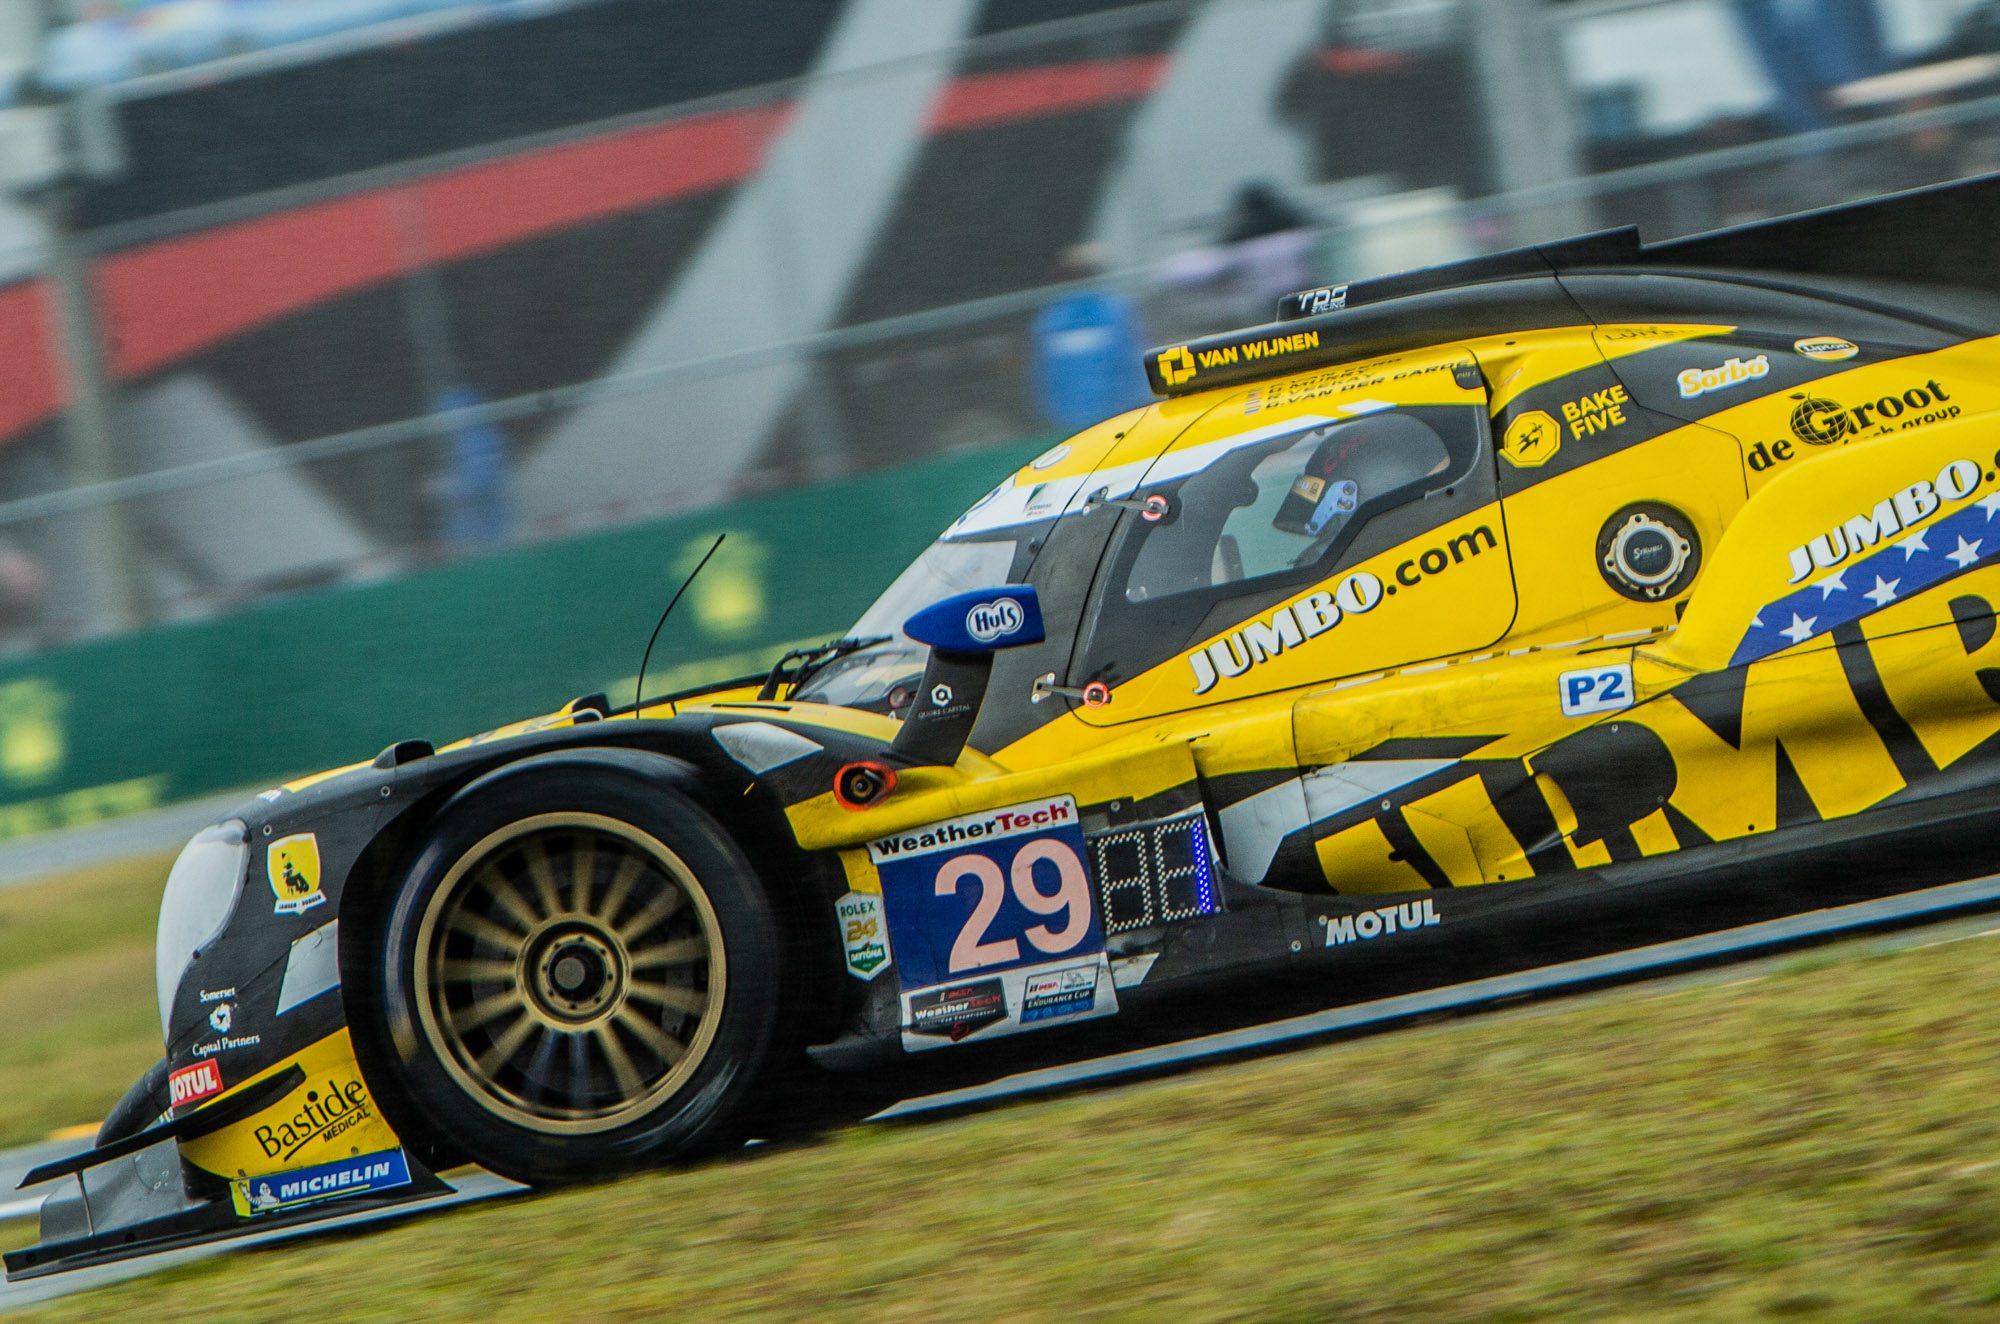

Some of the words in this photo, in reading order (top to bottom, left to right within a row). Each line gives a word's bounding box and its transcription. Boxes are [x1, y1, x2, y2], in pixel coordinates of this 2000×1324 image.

[1298, 285, 1348, 311] TDS
[1198, 345, 1239, 368] VAN
[1243, 331, 1319, 360] WIJNEN
[1679, 357, 1768, 397] Sorbo
[1561, 384, 1629, 423] BAKE
[1570, 404, 1627, 441] FIVE
[1748, 438, 1795, 472] de
[1796, 379, 1950, 442] Groot
[1788, 449, 2000, 585] JUMBO.
[1188, 524, 1498, 695] JUMBO.com
[1568, 671, 1625, 707] P2
[876, 803, 1068, 856] WeatherTech
[840, 901, 875, 917] ROLEX
[935, 838, 1091, 973] 29
[1326, 899, 1440, 948] MOTUL
[847, 916, 877, 942] 24
[199, 986, 236, 1002] Somerset
[192, 1038, 221, 1057] Capital
[222, 1034, 260, 1051] Partners
[253, 1079, 368, 1159] Bastide
[280, 1161, 390, 1199] MICHELIN
